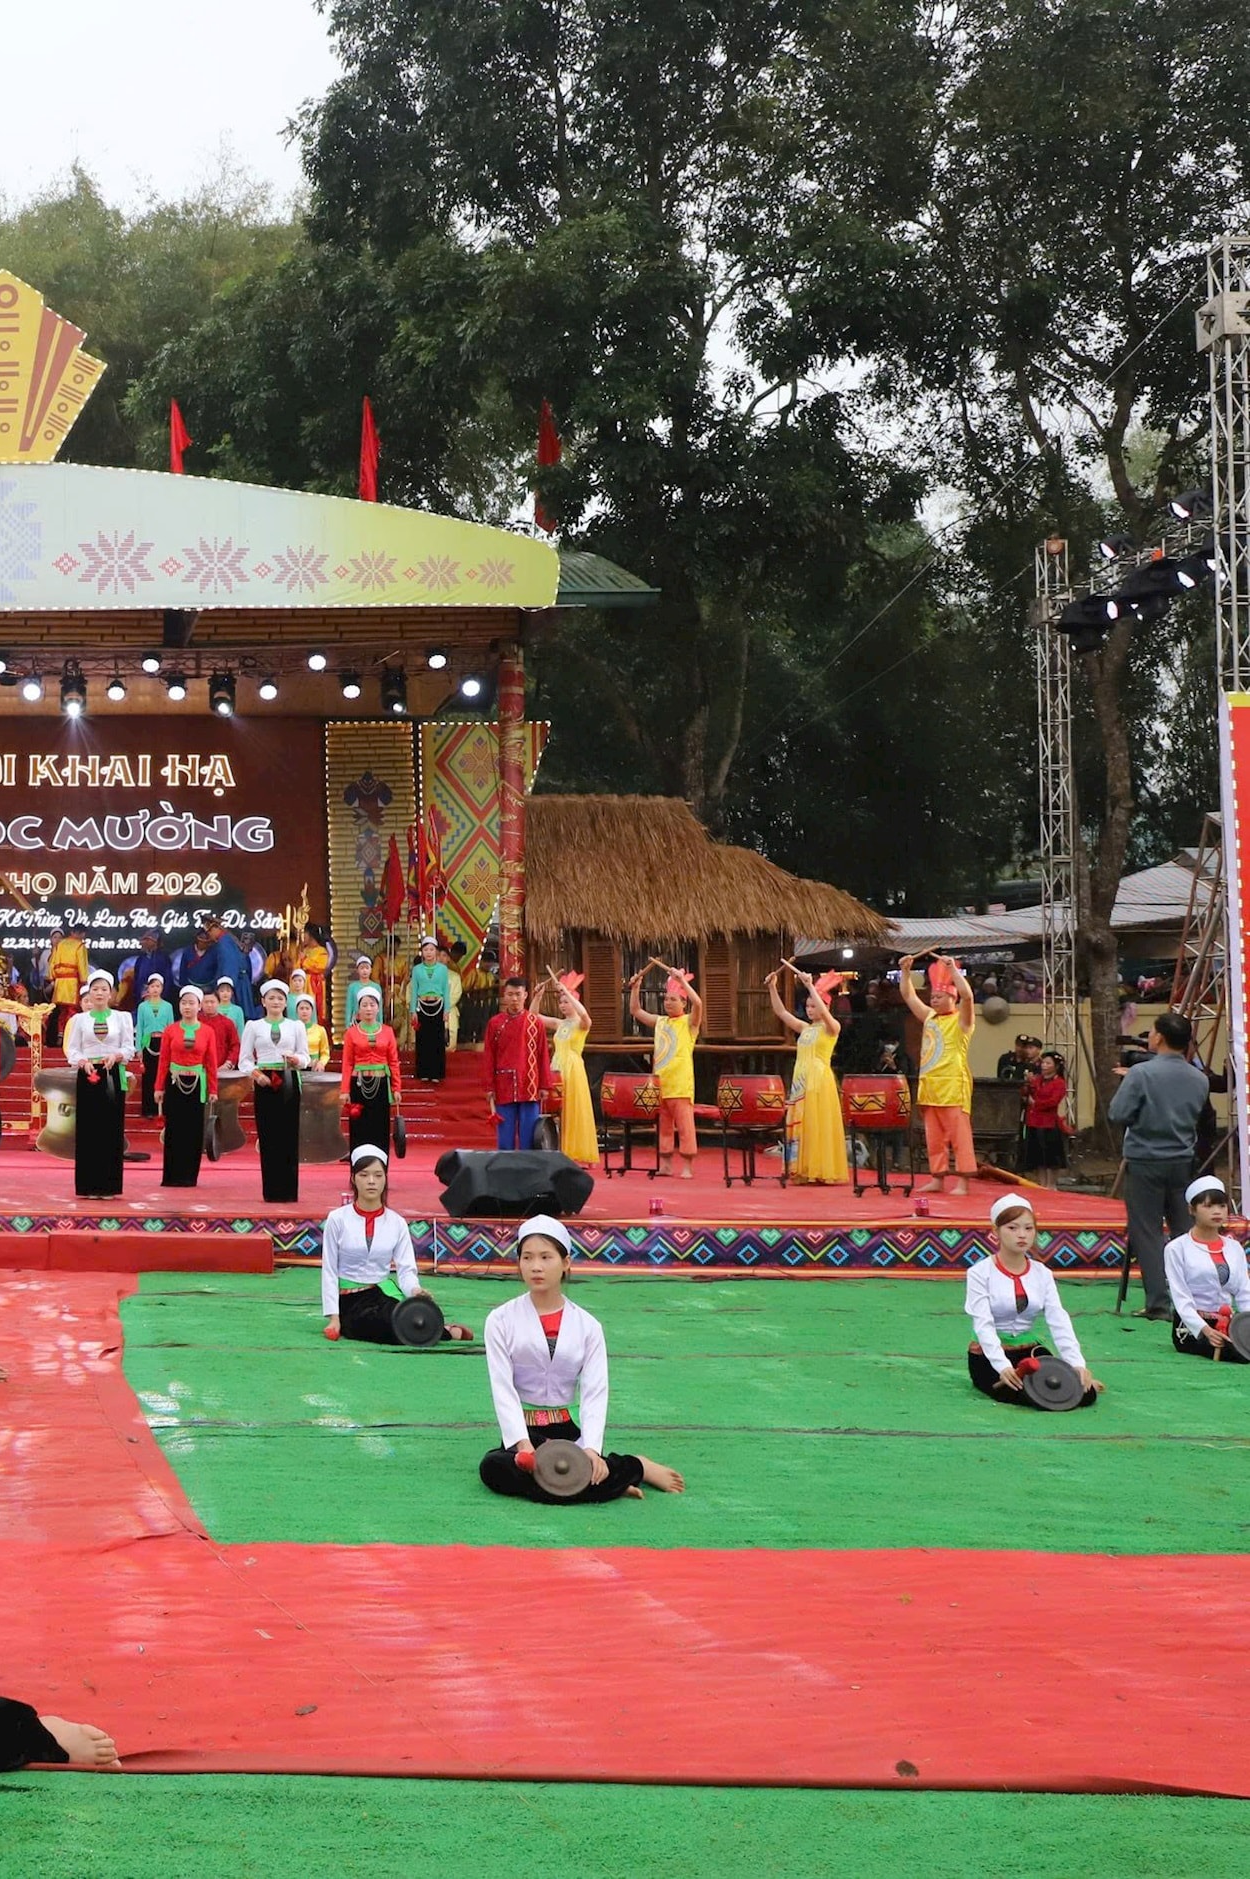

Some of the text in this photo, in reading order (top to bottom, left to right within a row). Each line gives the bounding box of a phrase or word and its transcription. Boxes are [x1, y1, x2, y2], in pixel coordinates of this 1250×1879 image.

[28, 754, 151, 787] KHAI
[160, 754, 236, 797] HẠ
[52, 801, 274, 852] MƯỜNG
[65, 866, 139, 895] NĂM
[146, 872, 222, 896] 2026
[91, 908, 128, 928] Lan
[160, 909, 190, 934] Giá
[221, 909, 247, 929] Di
